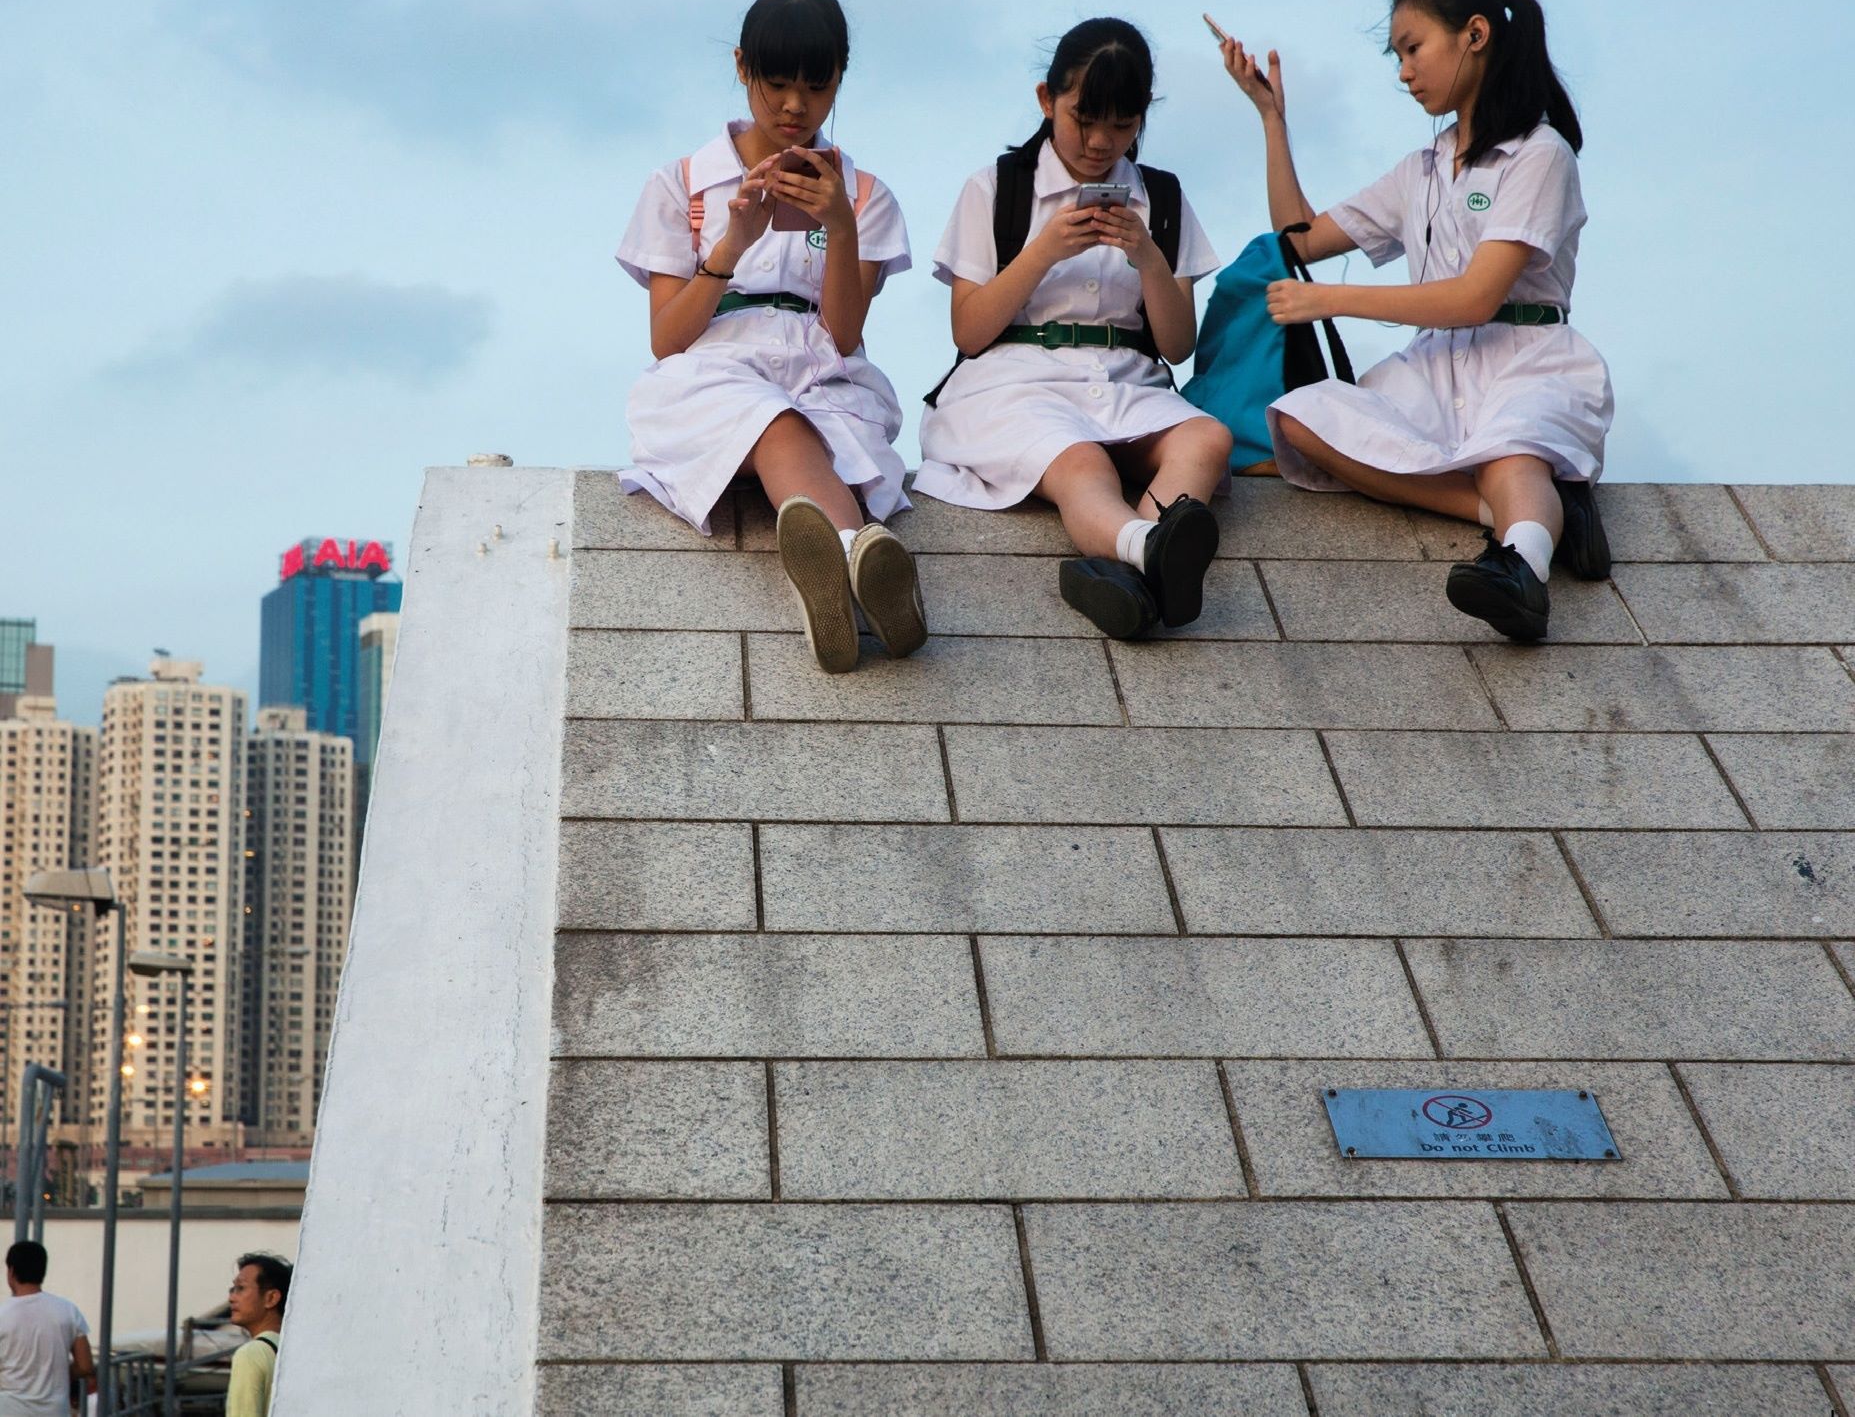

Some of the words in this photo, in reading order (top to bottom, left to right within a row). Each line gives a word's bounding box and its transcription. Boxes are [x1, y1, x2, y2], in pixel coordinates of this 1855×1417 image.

[312, 537, 391, 571] AIA
[1420, 1143, 1445, 1153] Do
[1451, 1144, 1481, 1153] not
[1486, 1143, 1537, 1154] Climb
